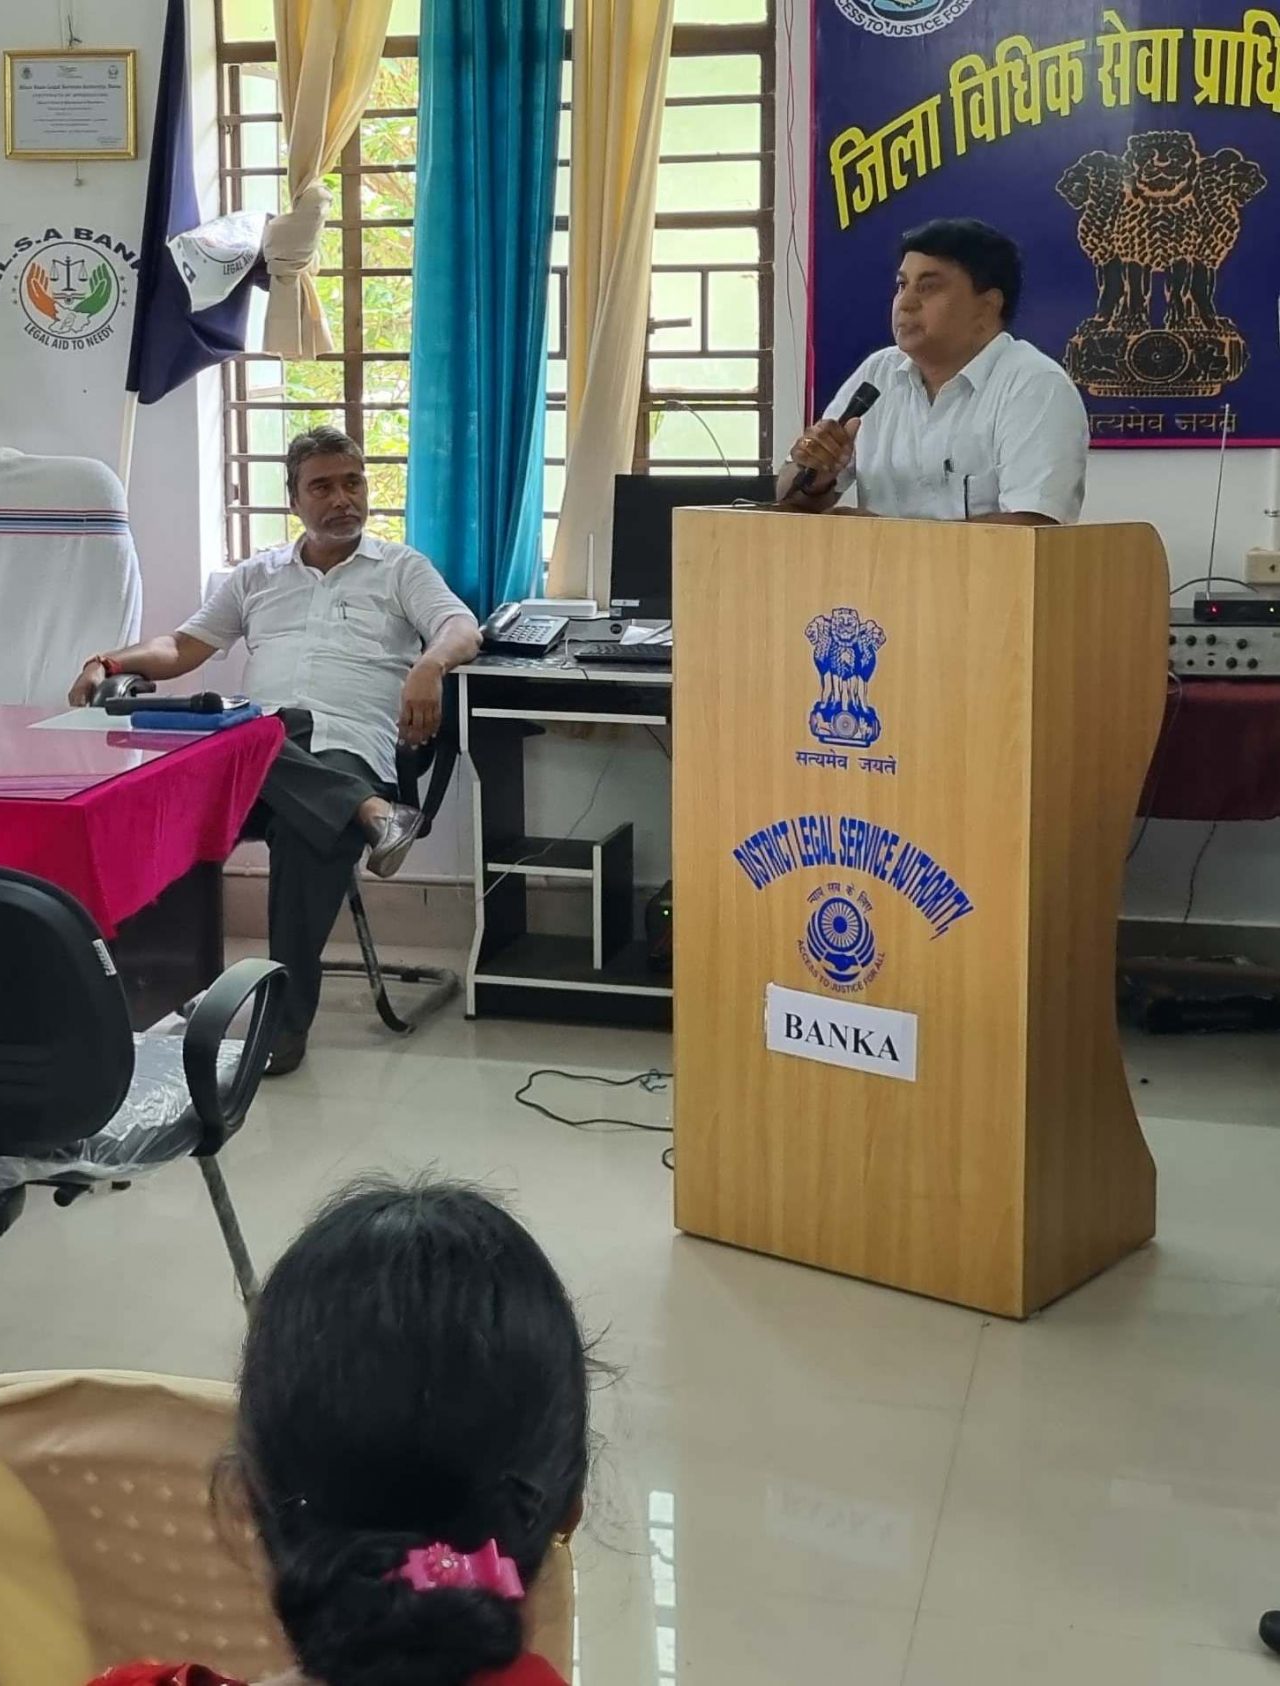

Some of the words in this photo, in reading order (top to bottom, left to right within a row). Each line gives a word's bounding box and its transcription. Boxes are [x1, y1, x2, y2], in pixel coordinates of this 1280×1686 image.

[866, 18, 884, 32] TO
[885, 15, 945, 36] JUSTICE
[829, 94, 942, 230] जिला
[949, 35, 1086, 155] विधिक
[1096, 9, 1184, 107] सेवा
[74, 227, 141, 272] BAN
[223, 262, 244, 275] LEGAL
[23, 322, 50, 346] LEGAL
[51, 339, 70, 350] AID
[71, 338, 85, 350] TO
[86, 324, 115, 347] NEEDY
[1089, 406, 1164, 433] त्यमेव
[795, 749, 848, 770] सत्यमेव
[857, 755, 897, 775] जयते
[733, 819, 797, 890] DISTRICT
[791, 815, 836, 867] LEGAL
[839, 816, 900, 881] SERVICE
[819, 975, 830, 987] TO
[831, 981, 864, 993] JUSTICE
[784, 1012, 900, 1062] BANKA
